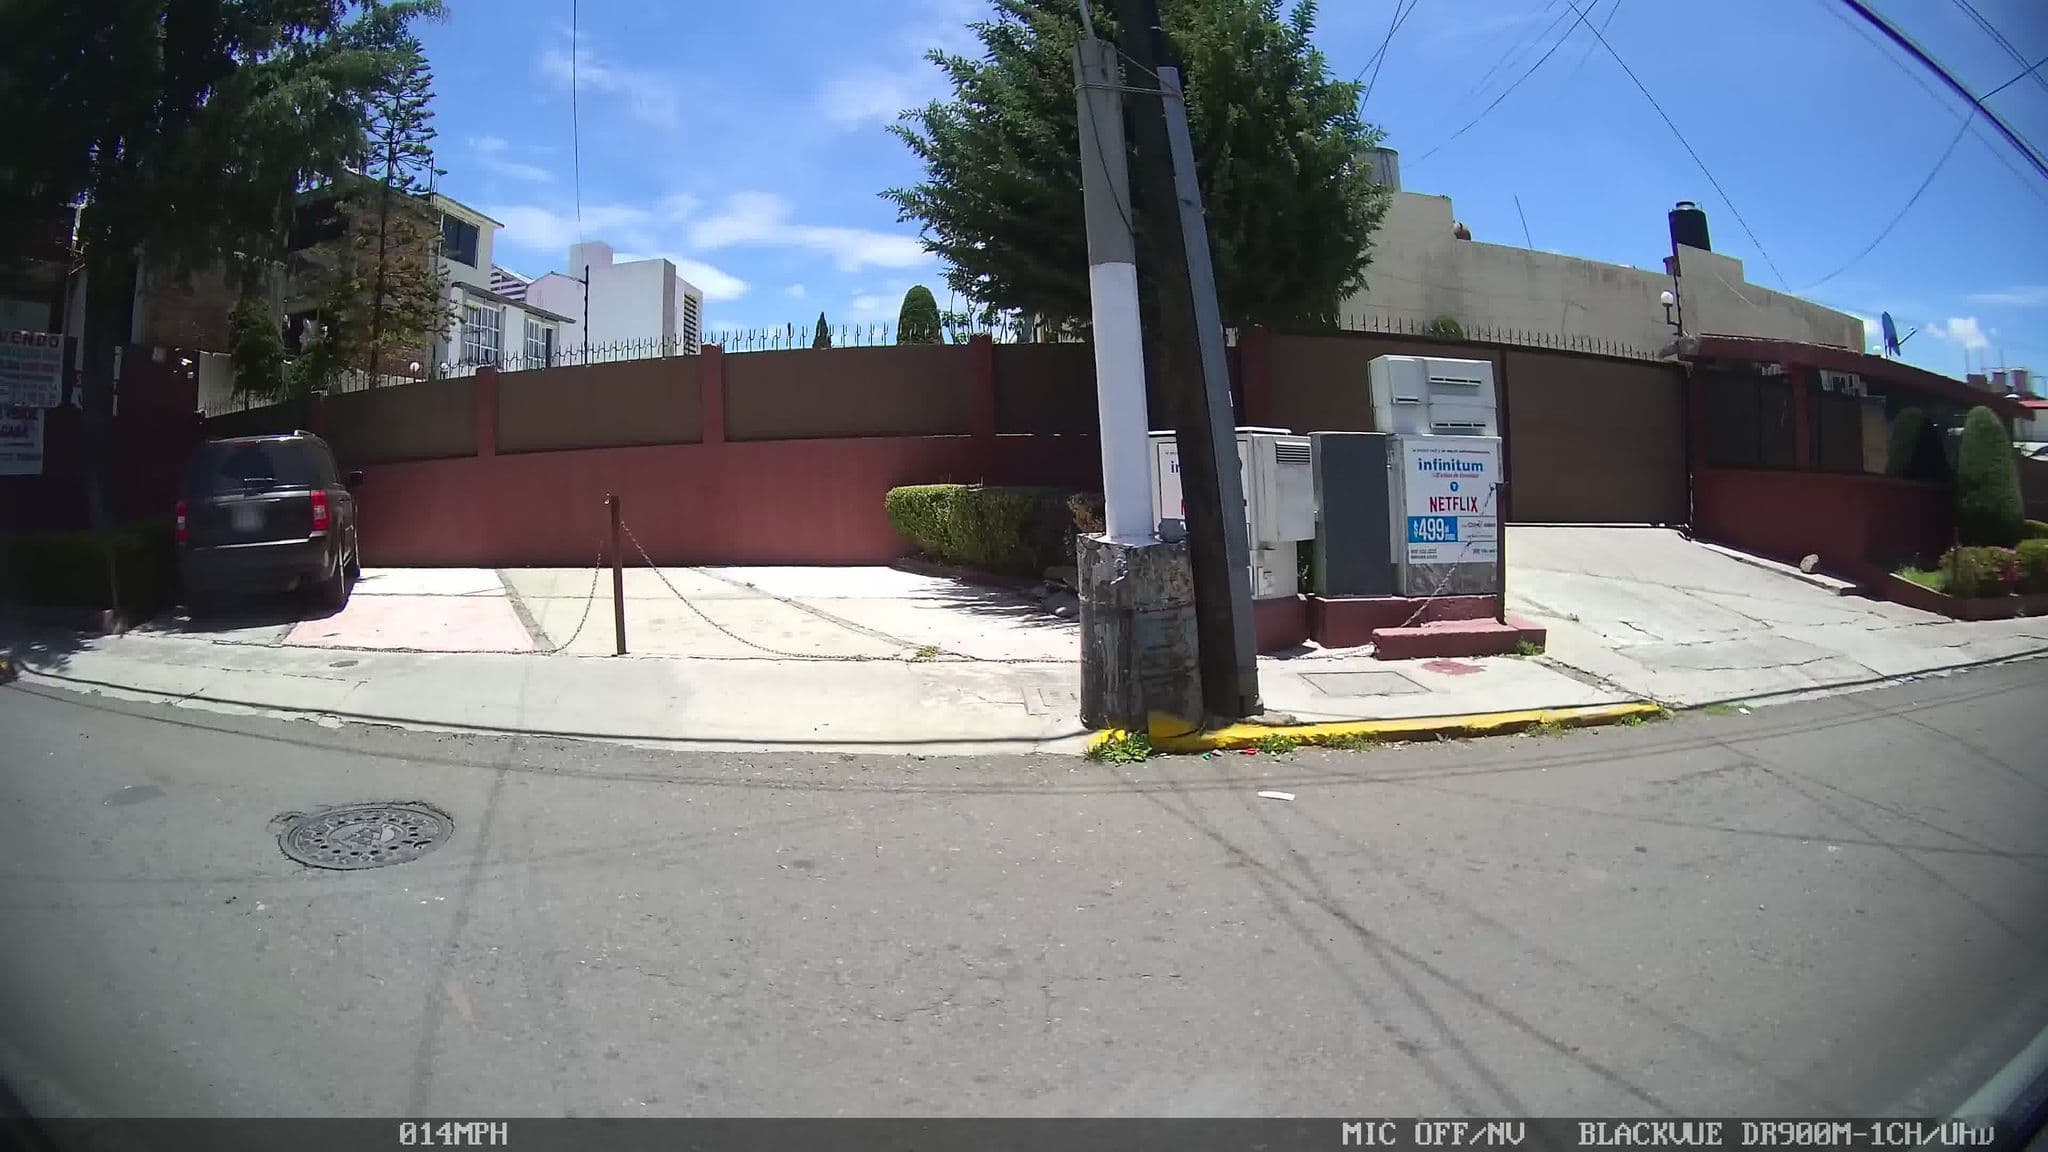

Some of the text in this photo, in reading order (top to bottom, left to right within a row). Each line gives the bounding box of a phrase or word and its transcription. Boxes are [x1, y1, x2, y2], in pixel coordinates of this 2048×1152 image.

[1418, 457, 1484, 472] infinitum
[1429, 496, 1478, 513] NETFLIX
[1413, 518, 1445, 541] $499
